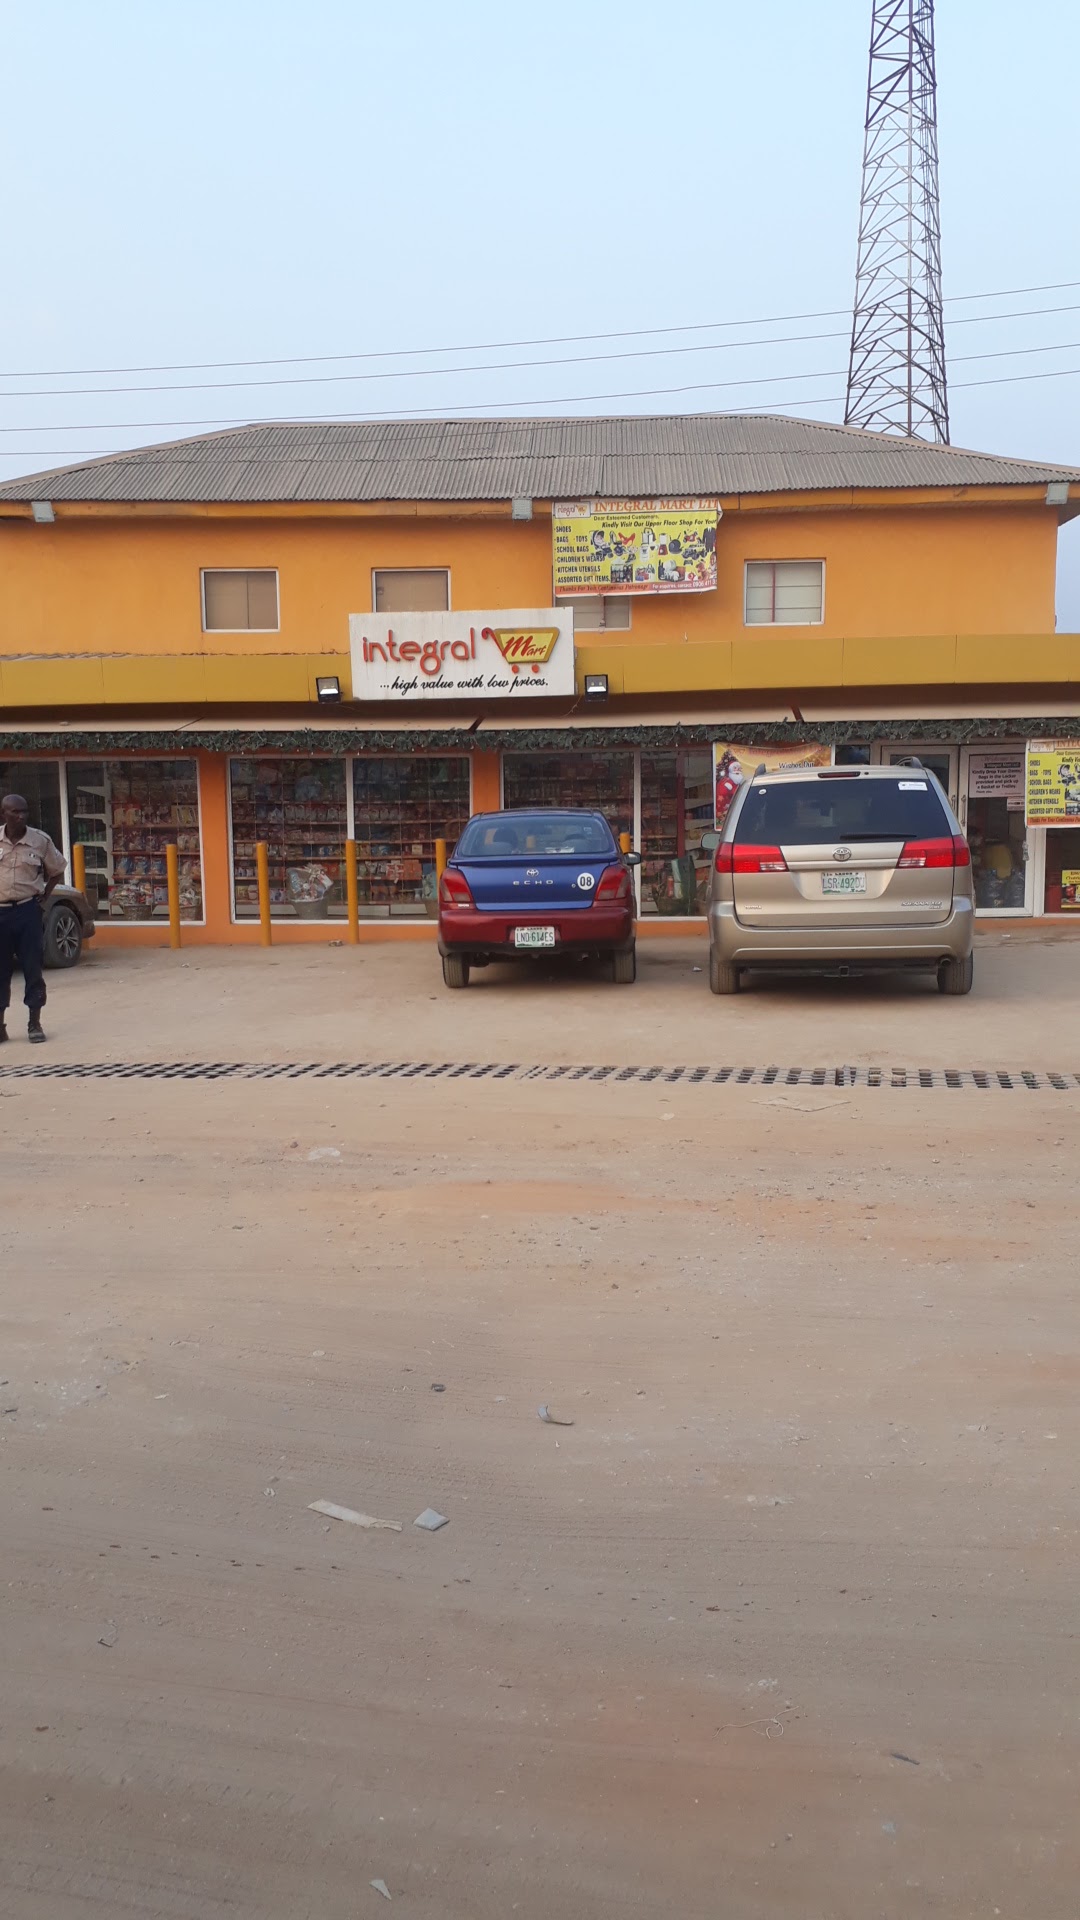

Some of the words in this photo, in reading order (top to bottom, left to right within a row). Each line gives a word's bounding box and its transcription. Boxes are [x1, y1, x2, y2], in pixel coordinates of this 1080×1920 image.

[594, 500, 656, 512] INTEGRAL
[660, 499, 695, 510] MART
[602, 521, 619, 529] Kindly
[576, 535, 588, 543] TOYS
[362, 627, 477, 676] integral
[502, 635, 547, 657] Mart
[420, 676, 454, 690] value
[457, 675, 484, 689] with
[487, 674, 509, 688] low
[509, 676, 549, 693] prices.
[579, 876, 593, 888] 08
